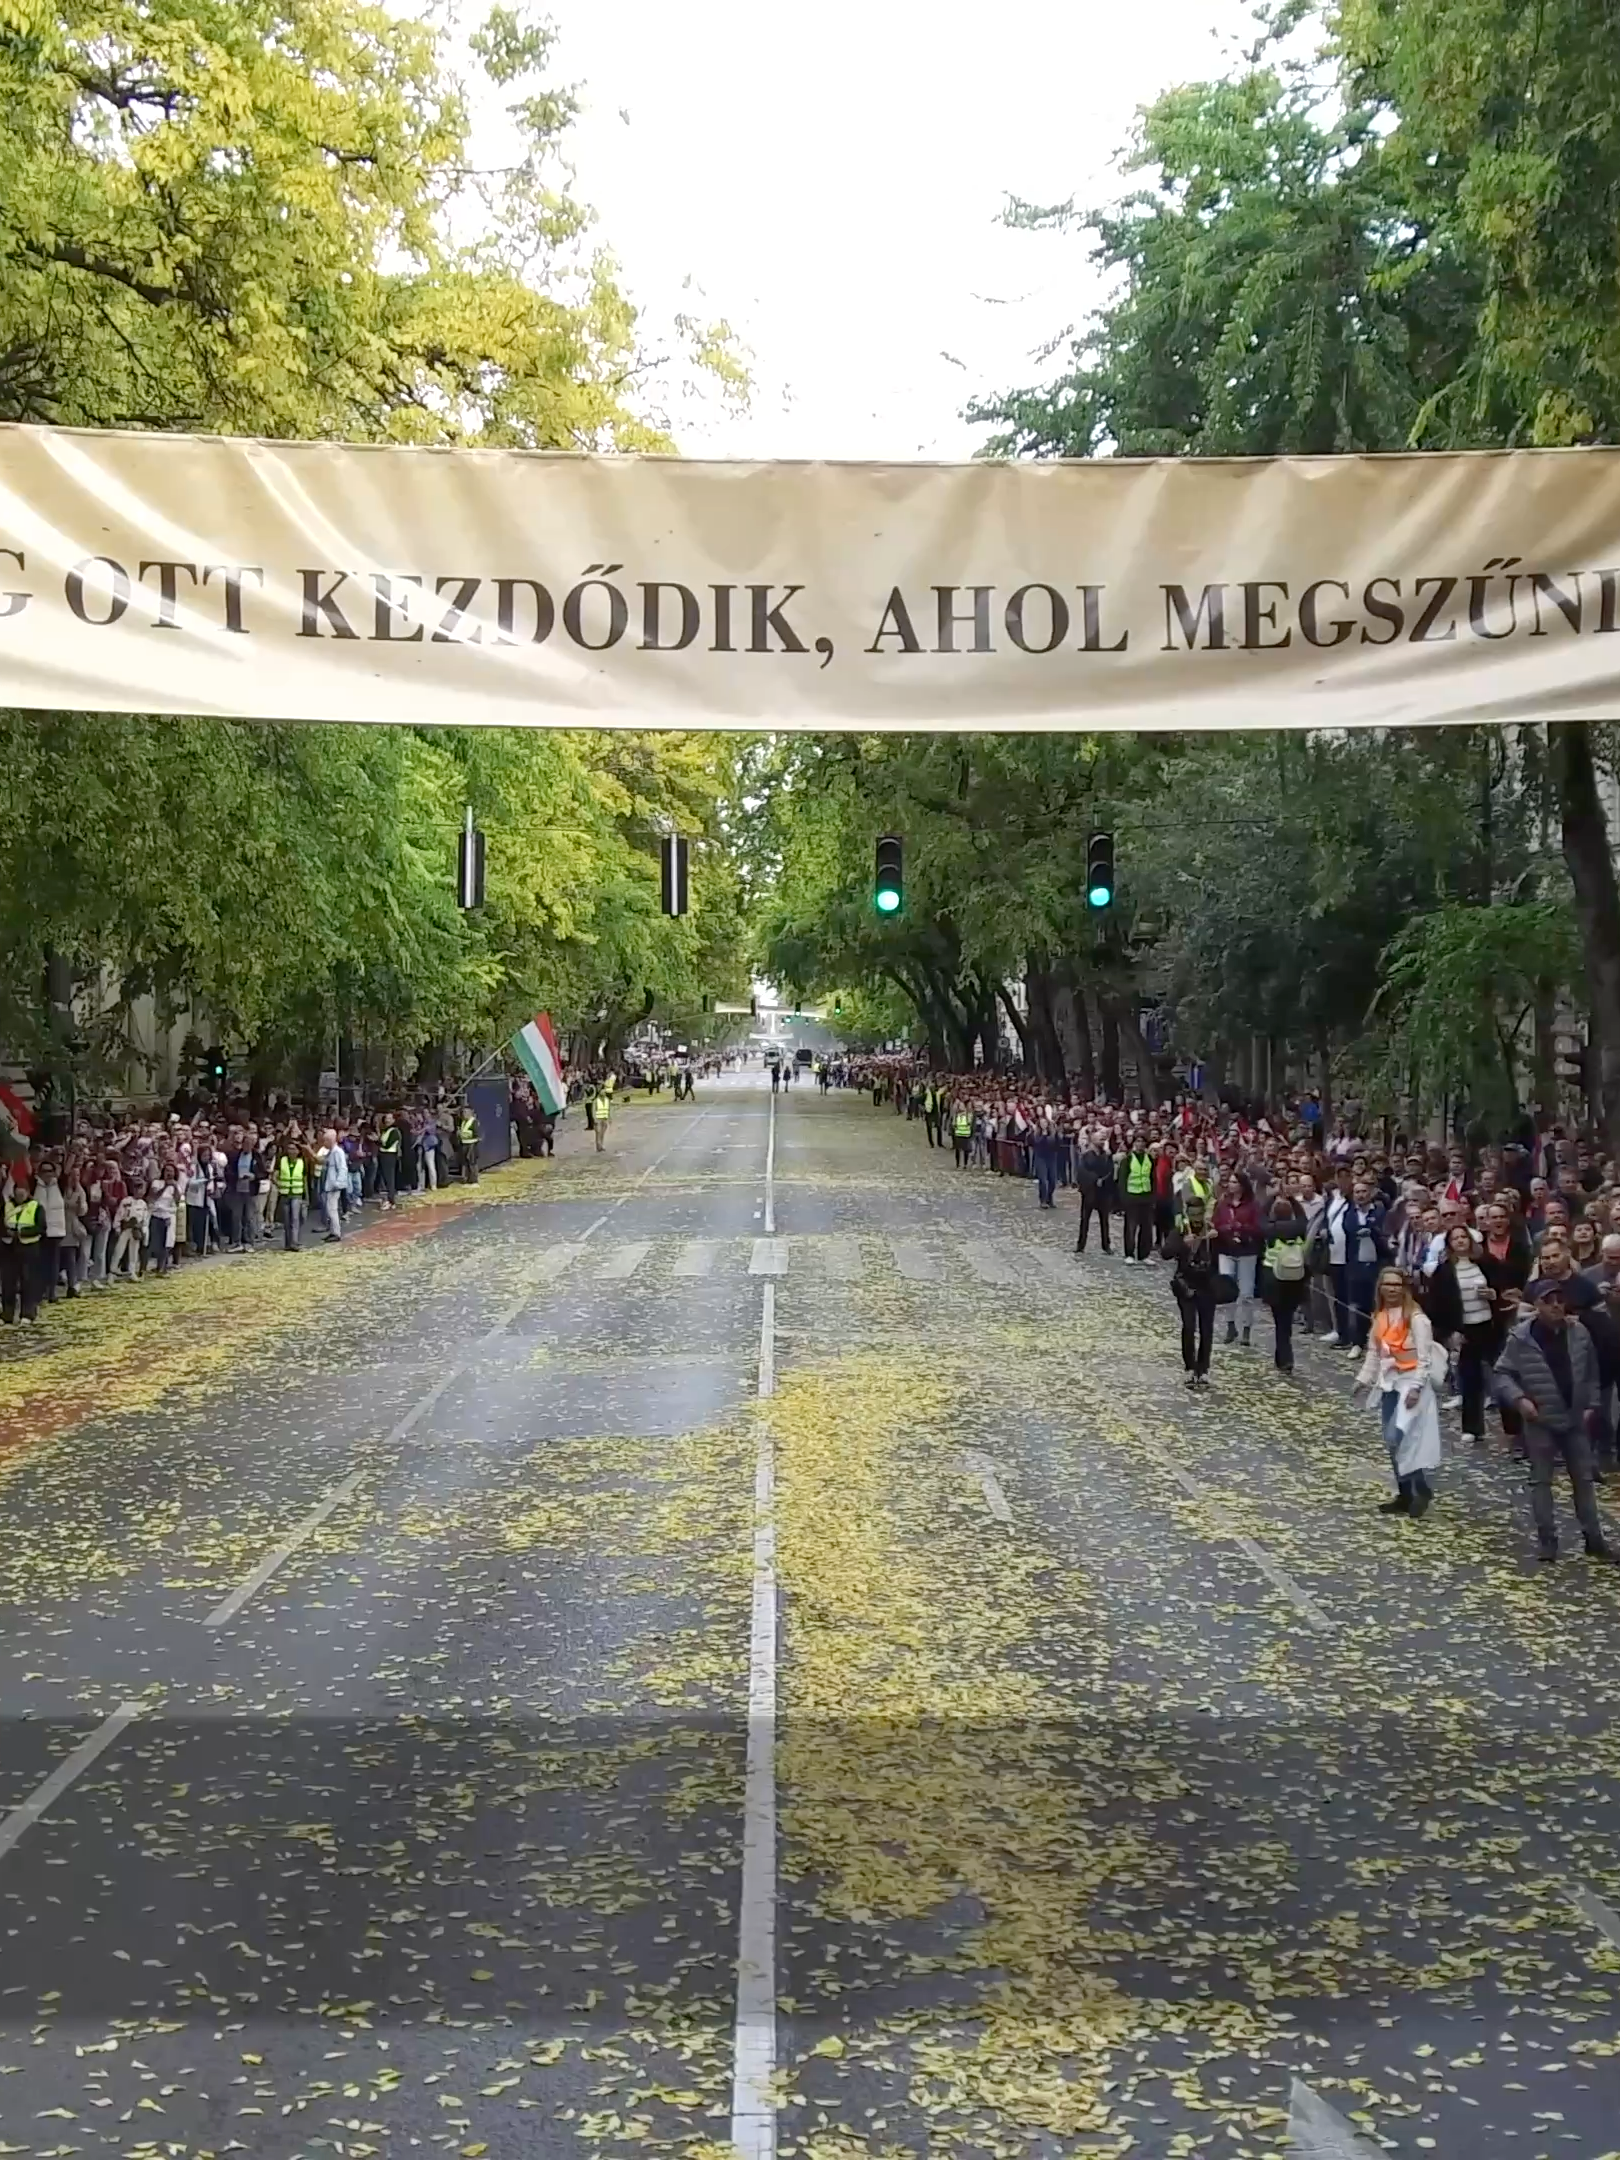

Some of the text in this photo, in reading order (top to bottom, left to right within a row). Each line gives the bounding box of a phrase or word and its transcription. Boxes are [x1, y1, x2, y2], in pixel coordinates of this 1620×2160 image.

[65, 556, 264, 633] OTT
[295, 564, 834, 669] KEZDŐDIK,
[865, 583, 1129, 653] AHOL
[1160, 557, 1620, 650] MEGSZŰNI
